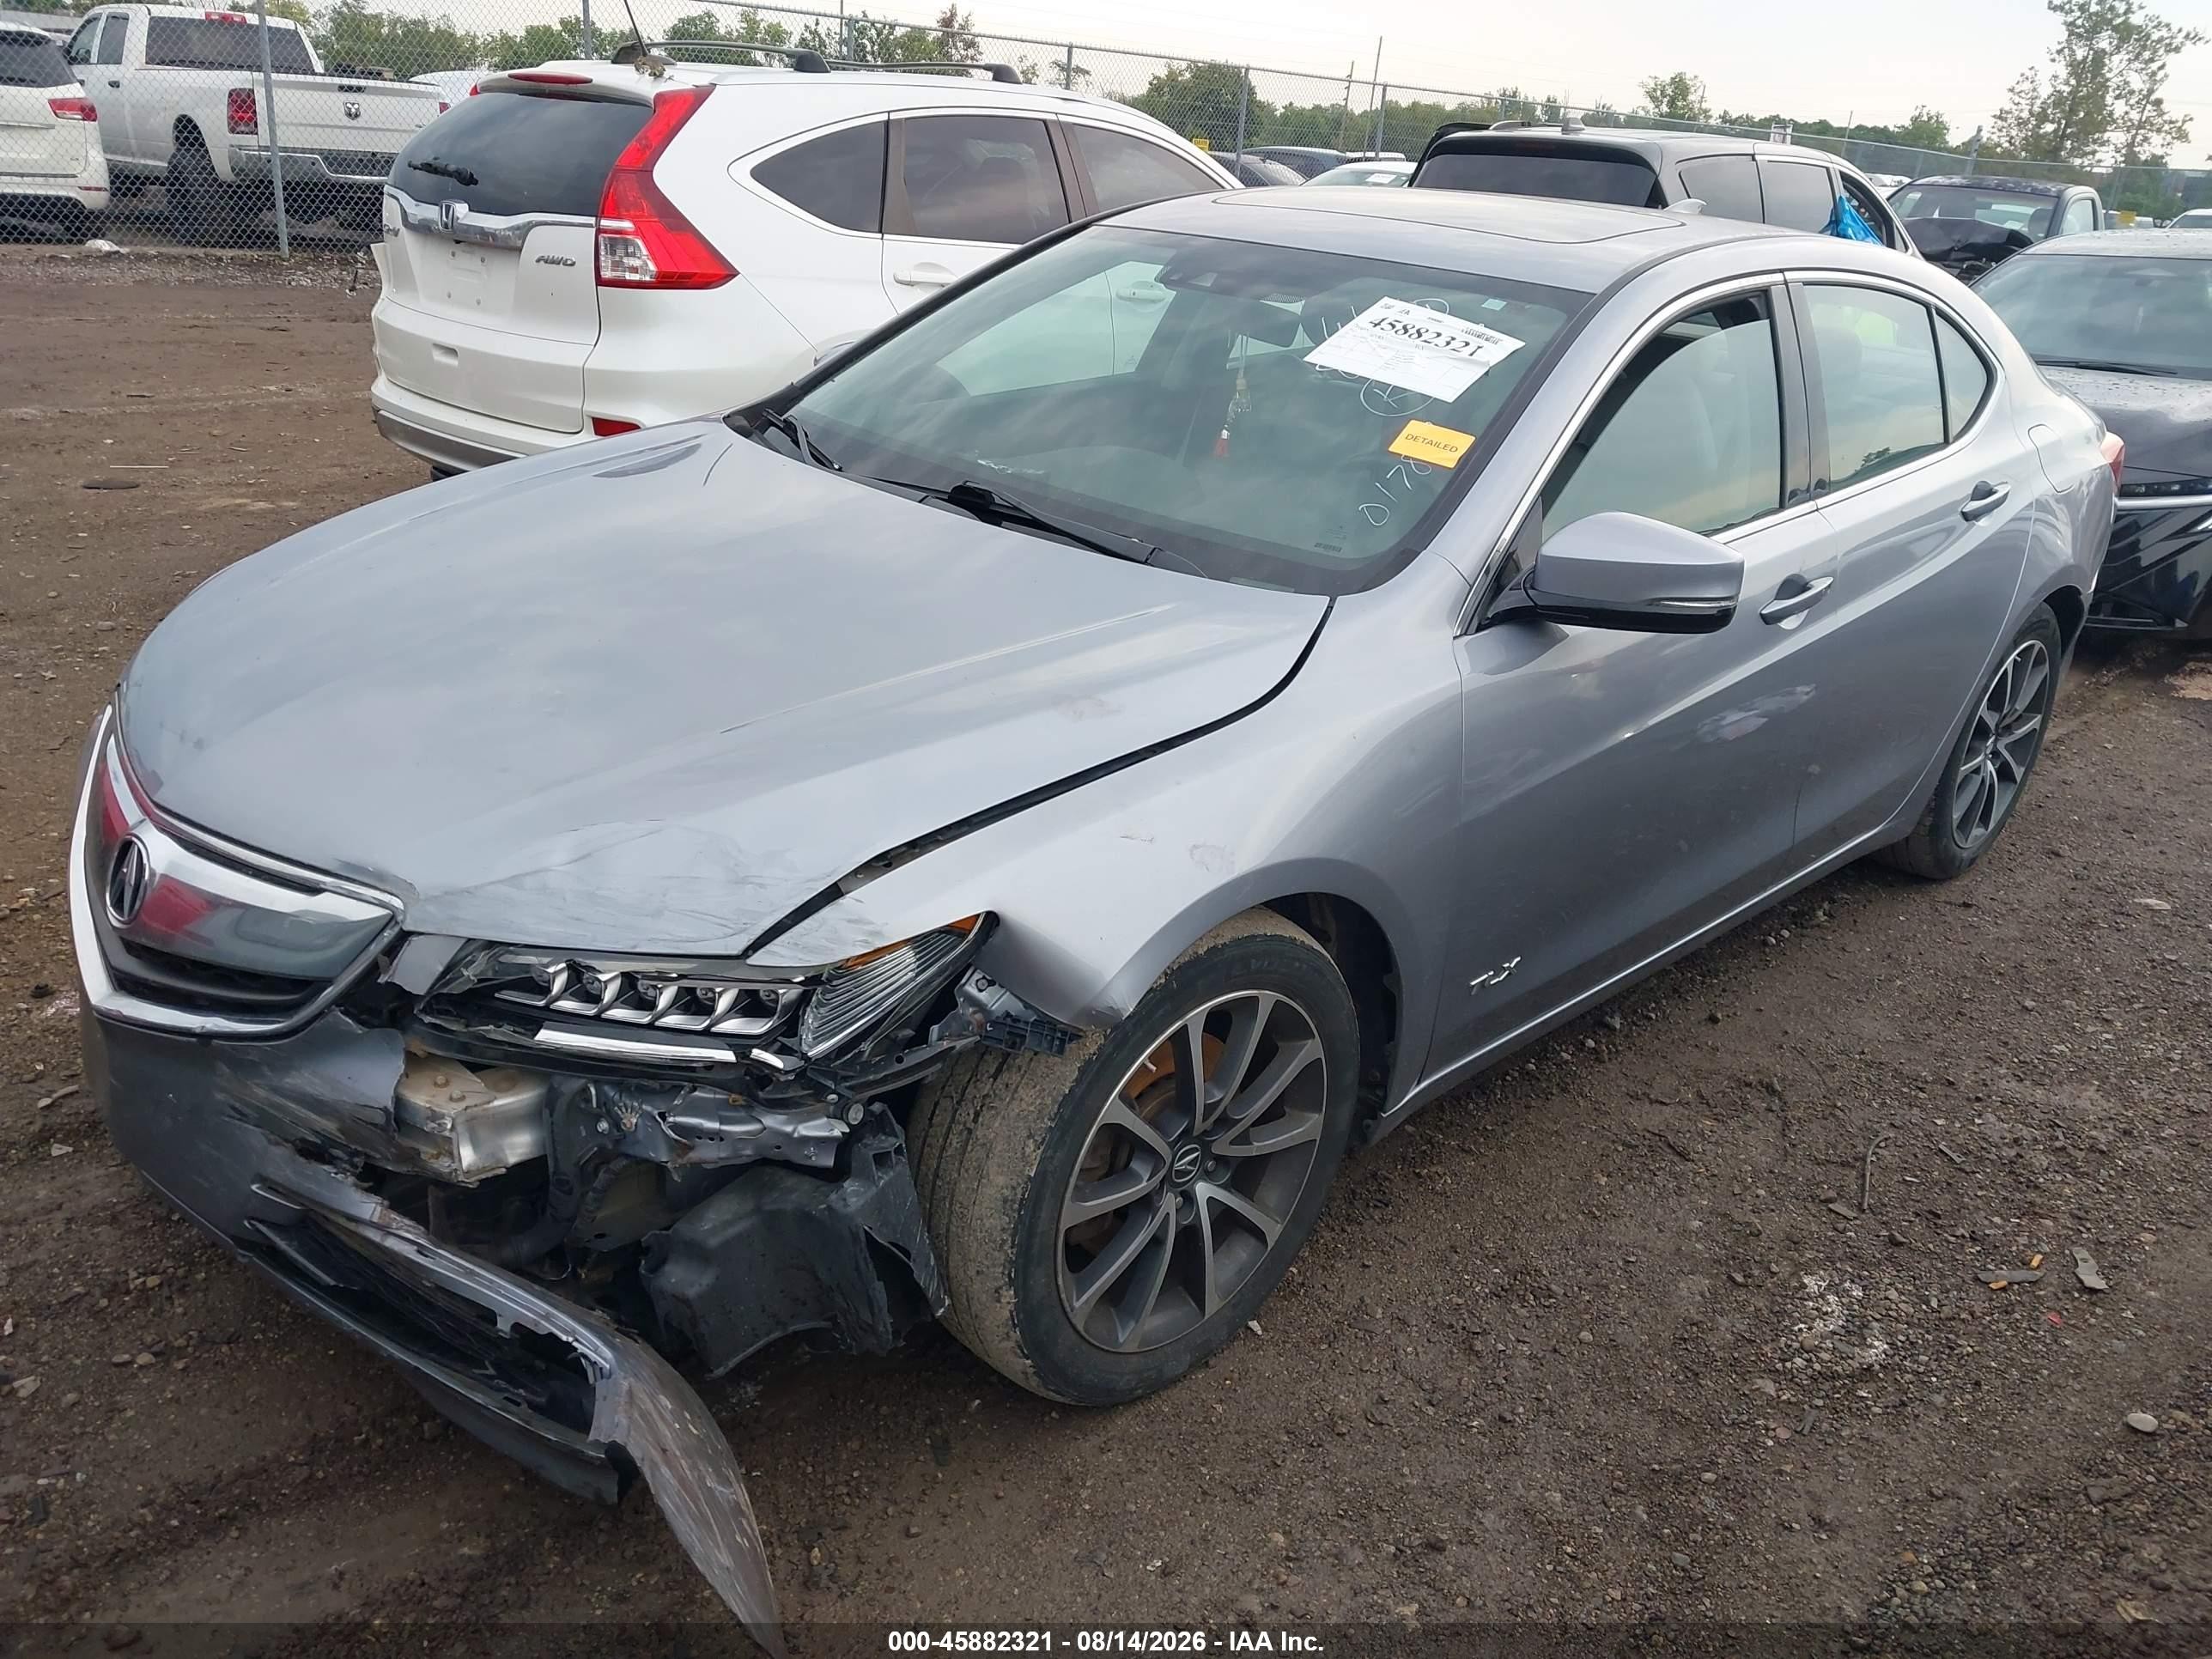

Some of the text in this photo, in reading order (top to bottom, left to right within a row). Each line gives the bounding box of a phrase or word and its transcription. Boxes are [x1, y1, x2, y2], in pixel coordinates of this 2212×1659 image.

[535, 254, 576, 266] AWD
[1369, 316, 1484, 357] 45882321
[1405, 433, 1458, 453] DETAILED
[1469, 956, 1522, 996] TLX
